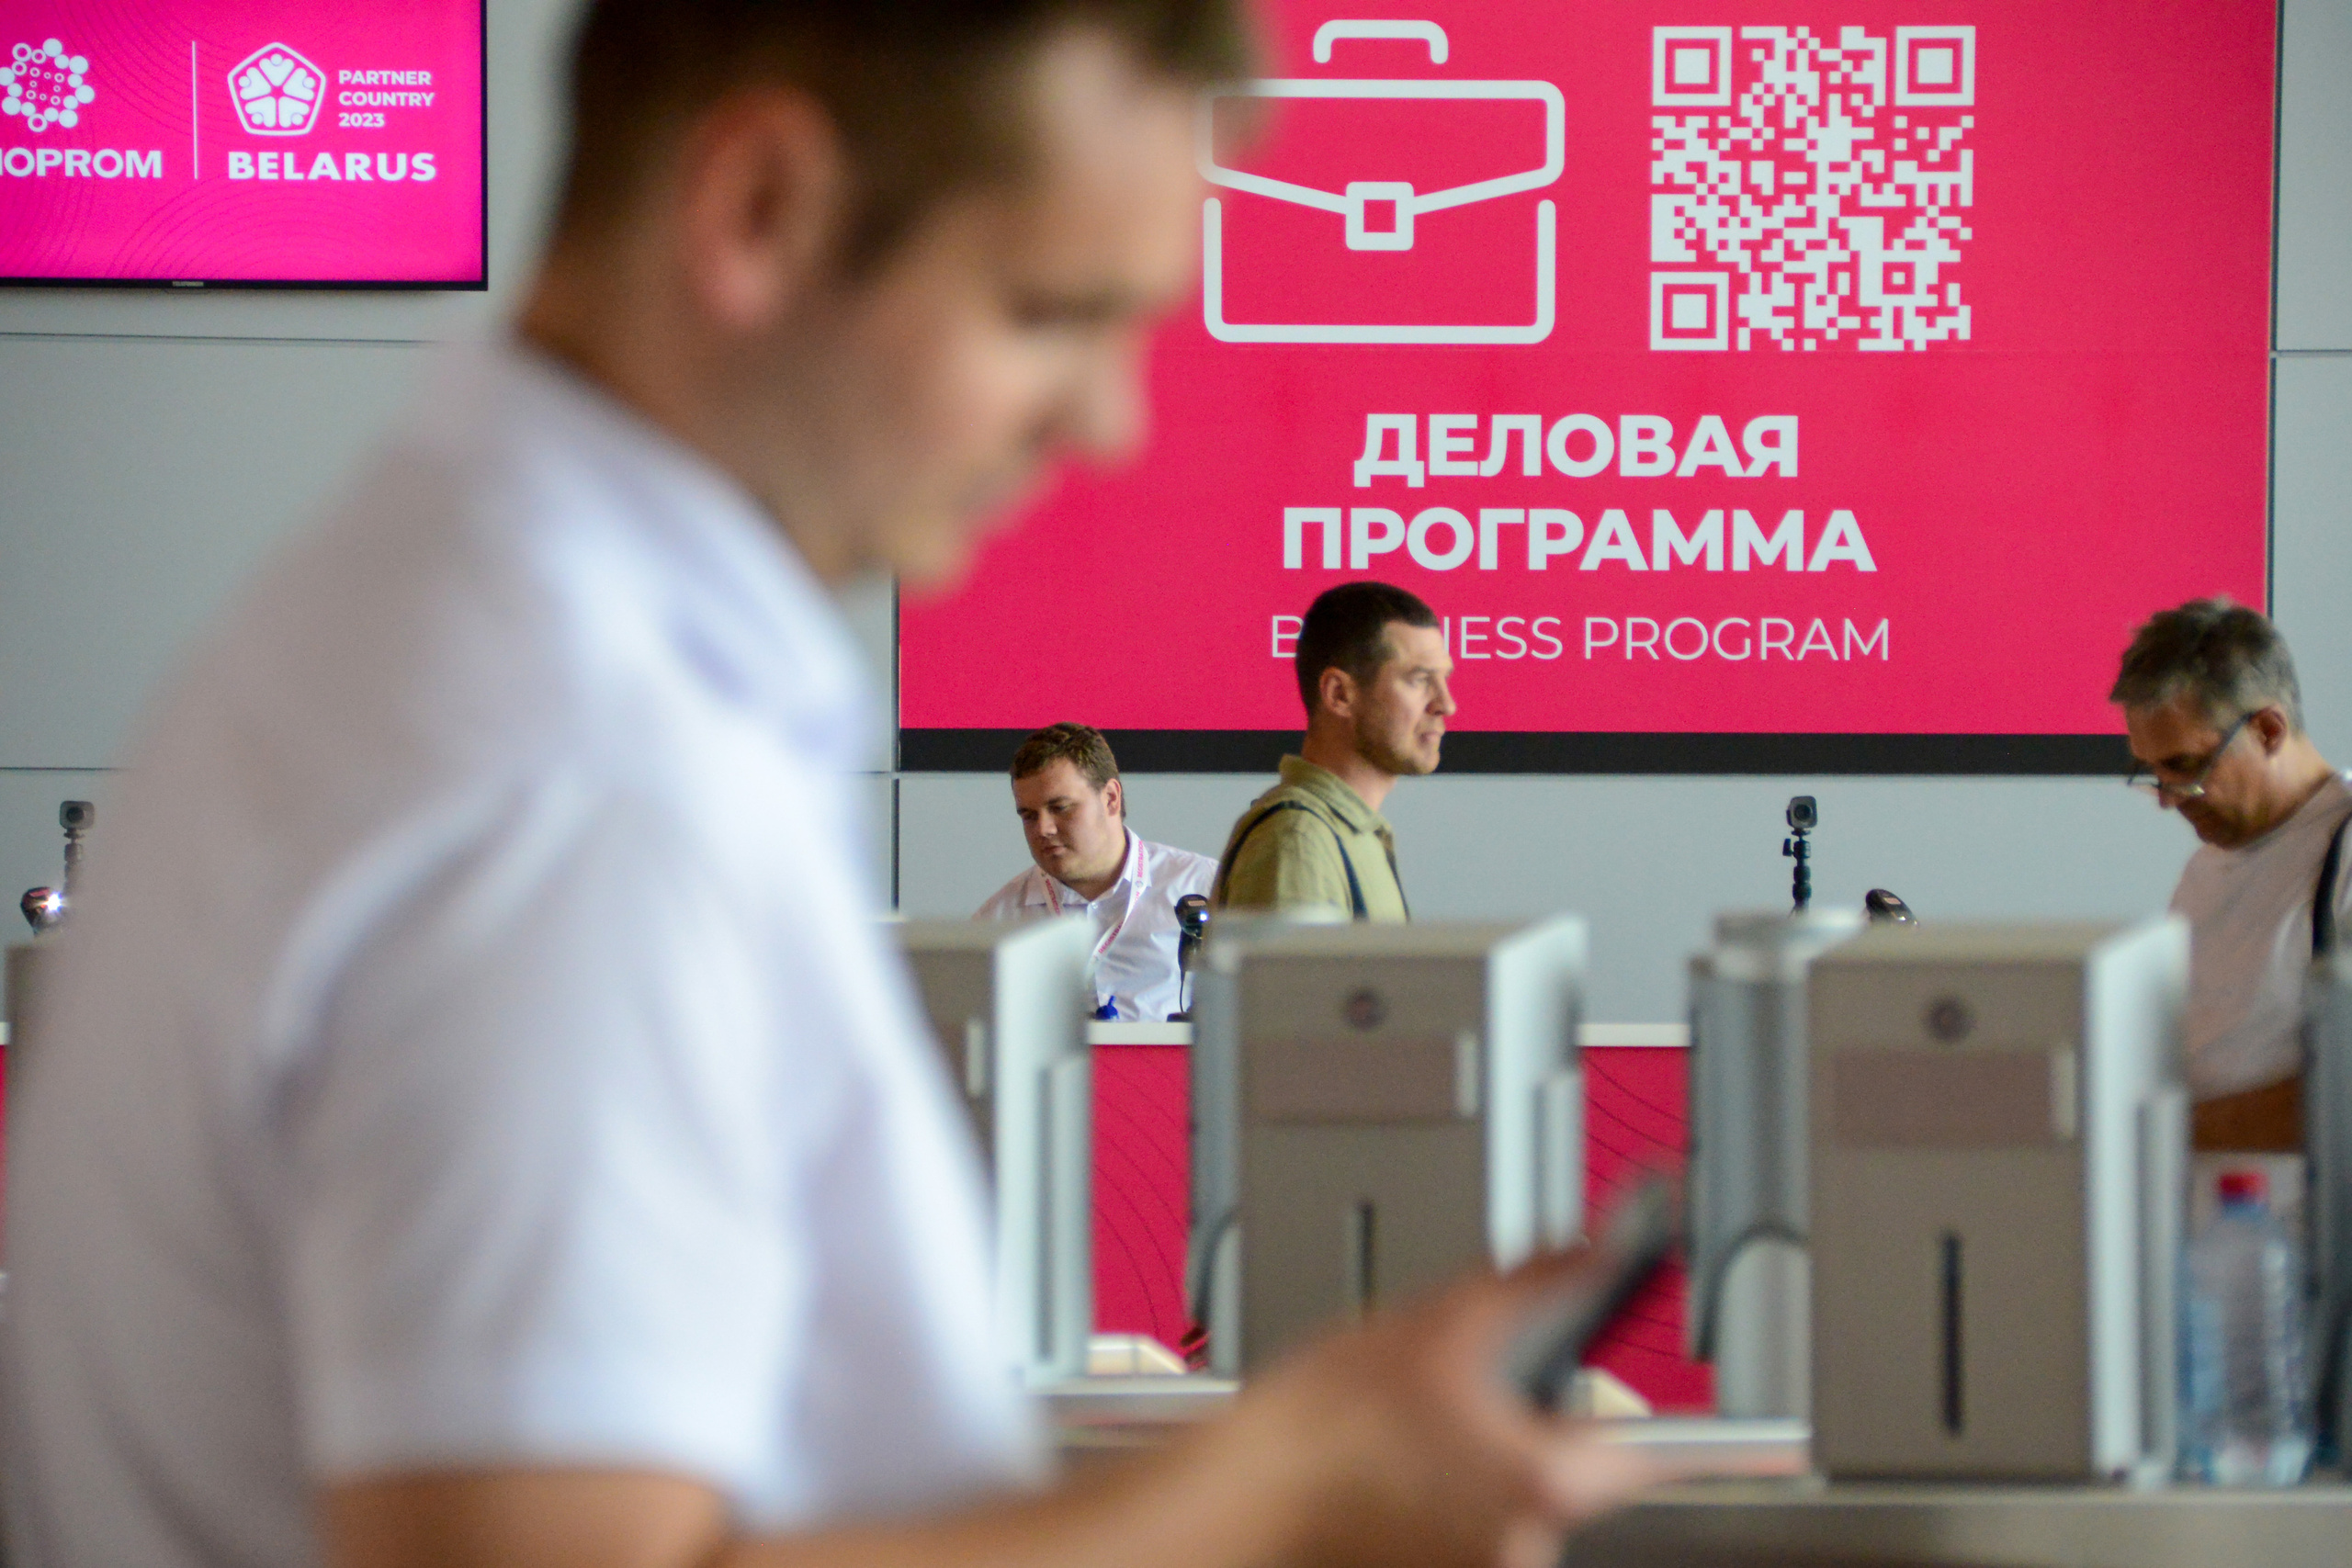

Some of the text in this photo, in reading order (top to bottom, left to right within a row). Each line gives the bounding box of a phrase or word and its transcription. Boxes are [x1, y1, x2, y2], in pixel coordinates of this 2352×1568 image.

[338, 70, 432, 85] PARTNER
[338, 91, 435, 107] COUNTRY
[338, 112, 385, 128] 2023
[0, 147, 162, 178] OPROM
[228, 151, 436, 182] BELARUS
[1353, 412, 1799, 488] ДЕЛОВАЯ
[1283, 506, 1878, 572] ПРОГРАММА
[1272, 615, 1889, 661] BESS PROGRAM
